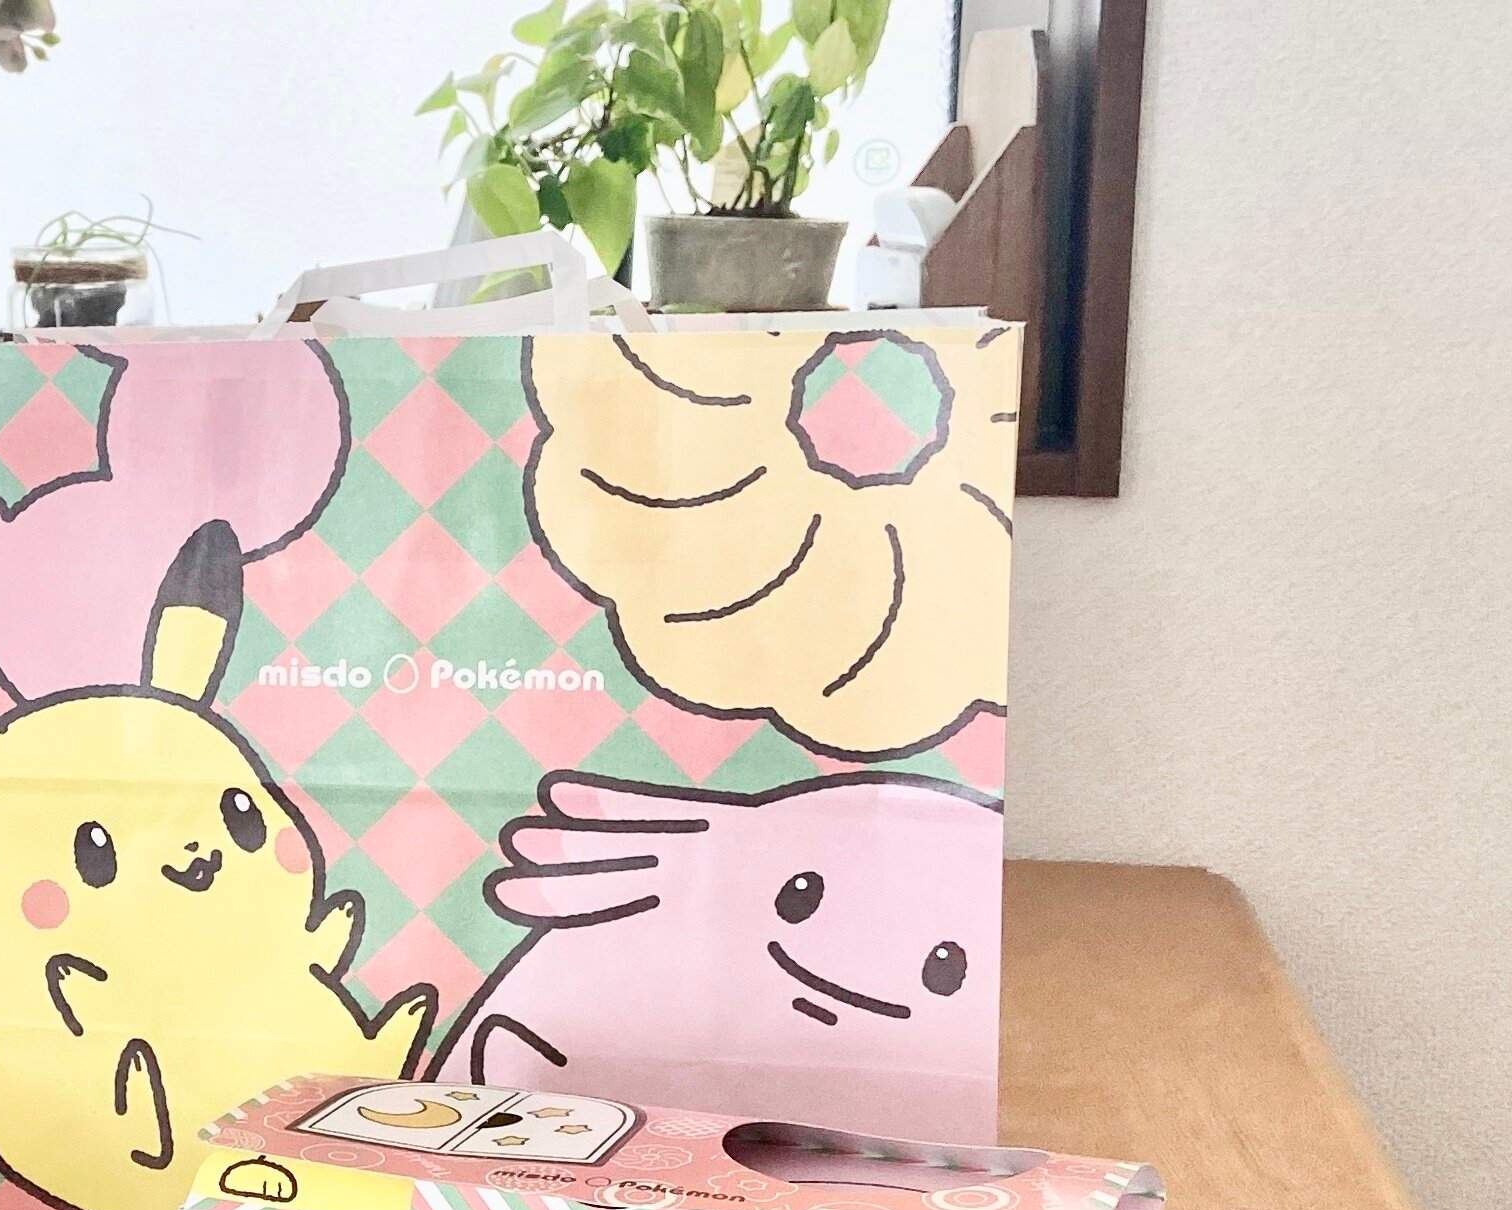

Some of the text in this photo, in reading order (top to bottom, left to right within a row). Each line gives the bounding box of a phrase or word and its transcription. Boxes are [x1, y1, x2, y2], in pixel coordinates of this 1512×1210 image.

[257, 657, 606, 693] misdo Pokémon
[492, 1169, 747, 1203] misdo Pokémon
